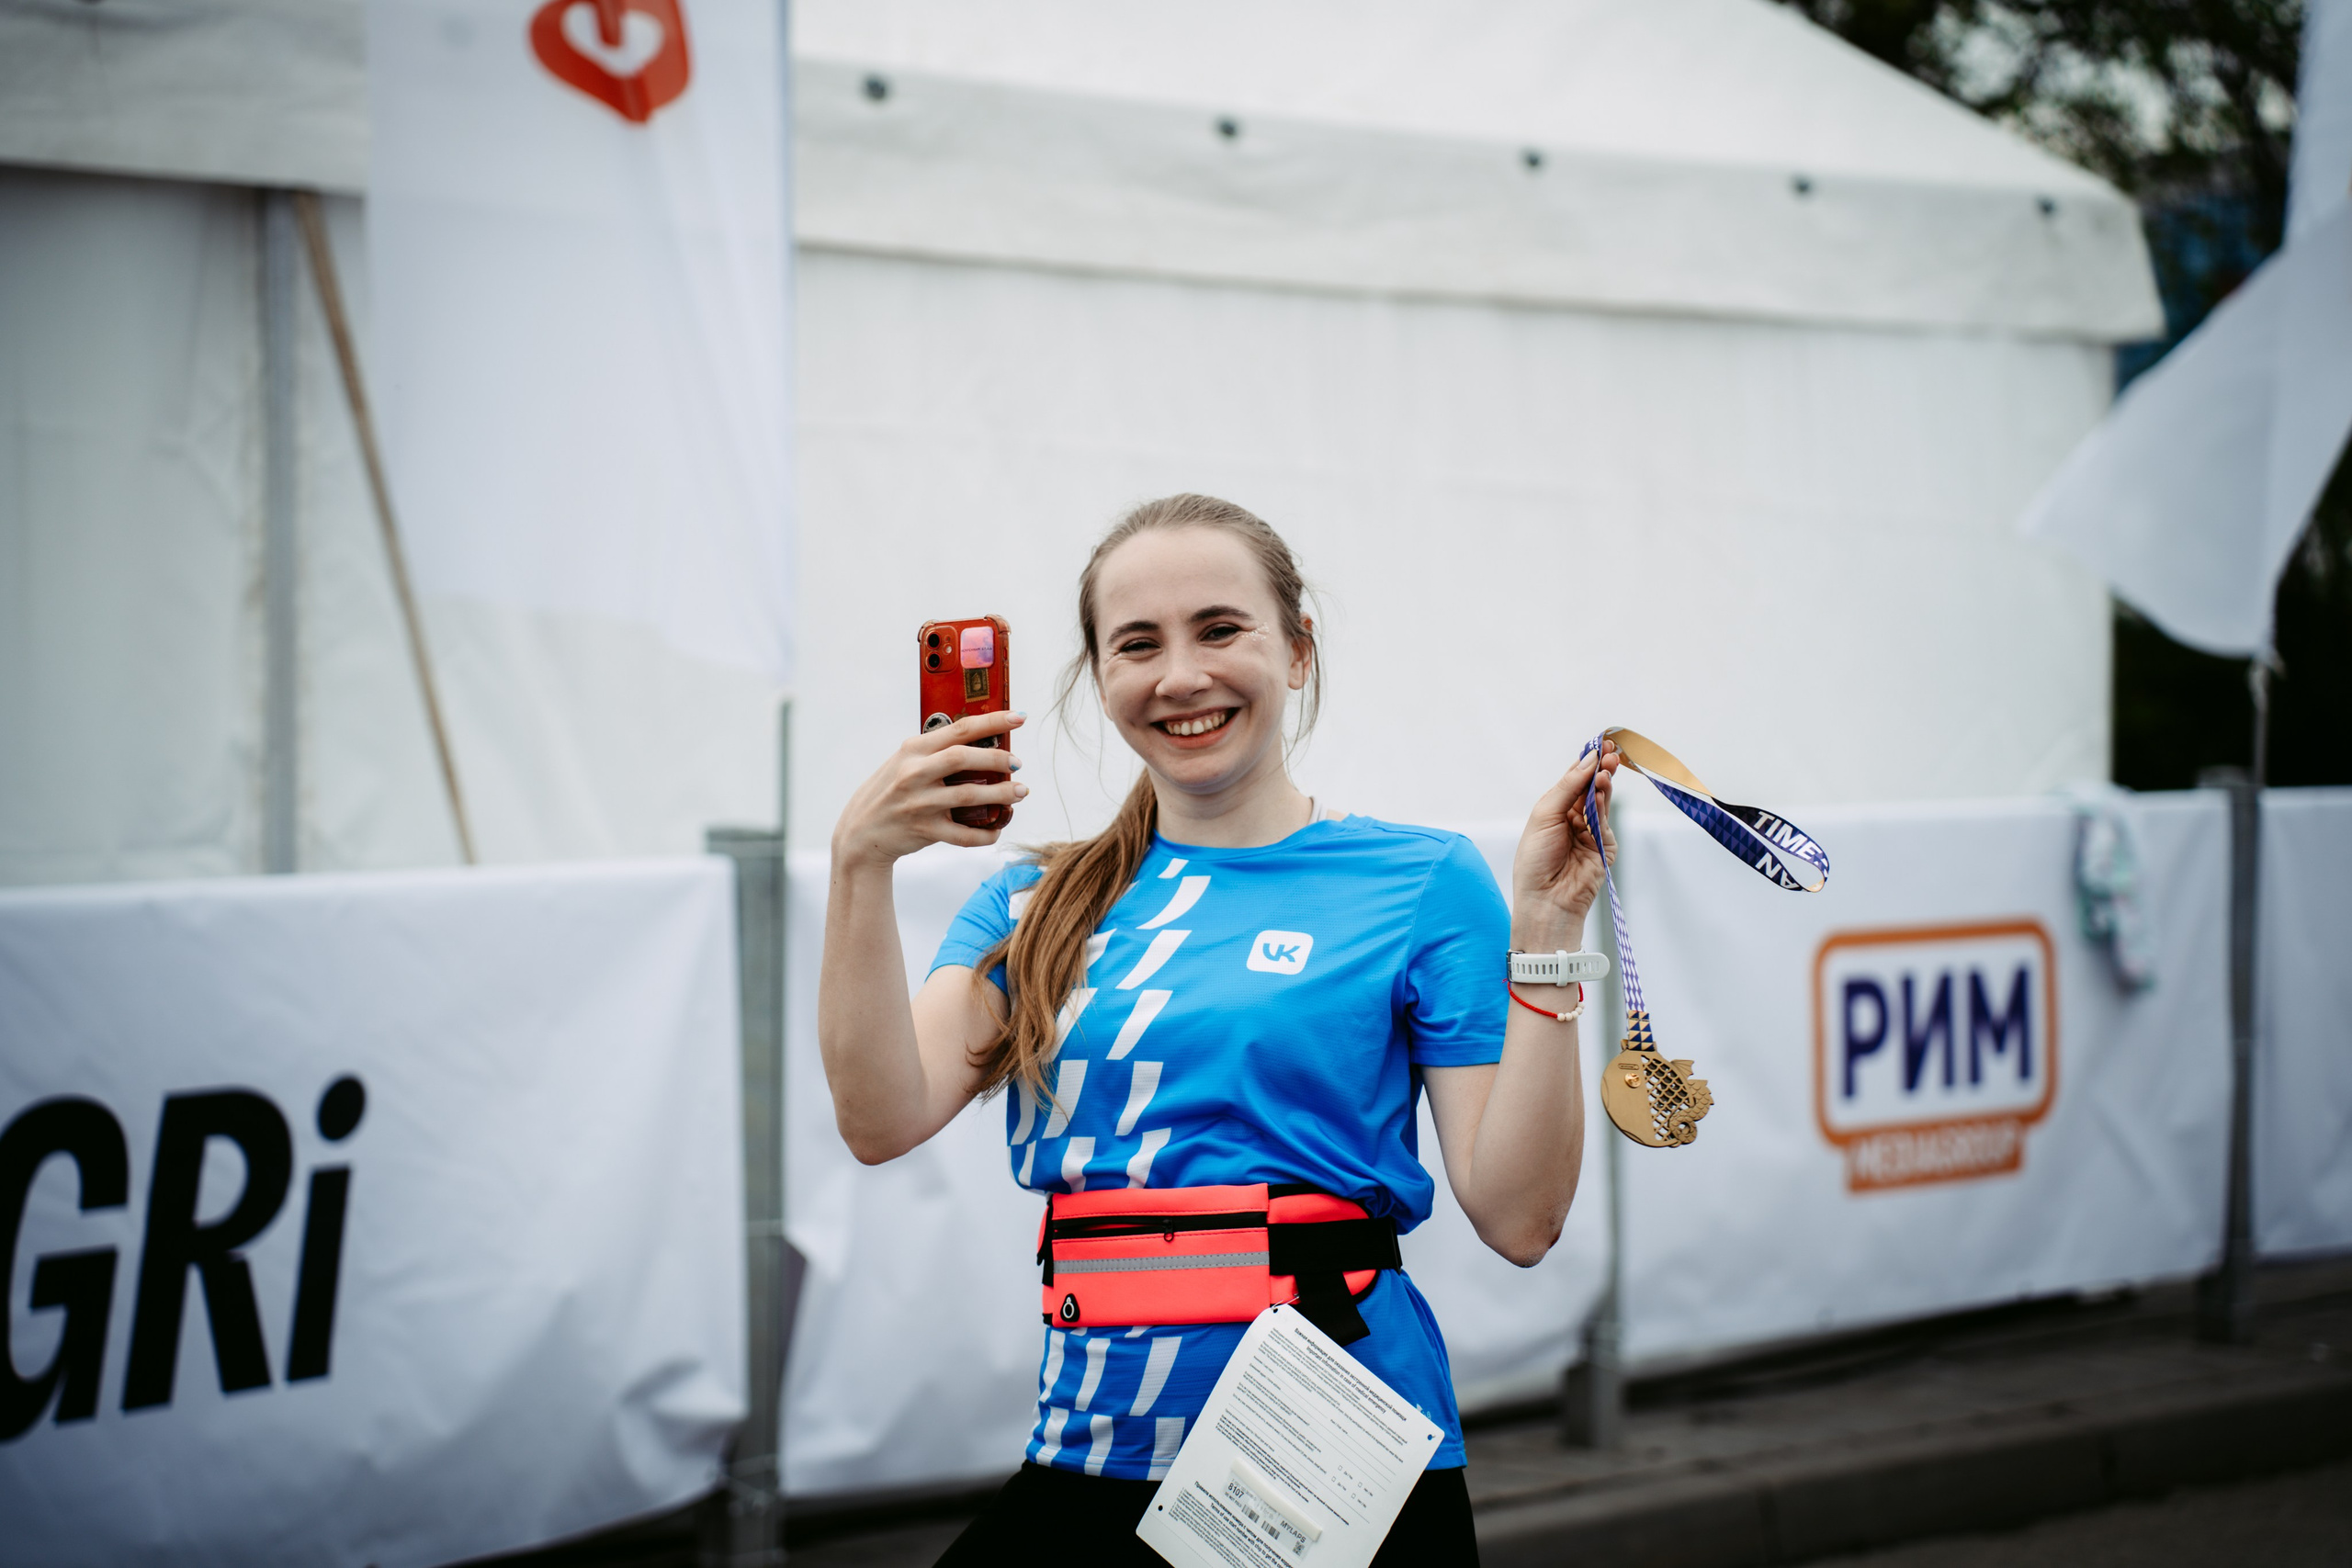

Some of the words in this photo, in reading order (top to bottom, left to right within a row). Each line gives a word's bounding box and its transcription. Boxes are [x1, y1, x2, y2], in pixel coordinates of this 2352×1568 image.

[1262, 942, 1301, 963] VK
[1841, 960, 2032, 1100] РИМ
[1306, 1346, 1322, 1360] Important
[1321, 1359, 1340, 1375] information
[1355, 1386, 1368, 1398] medical
[1367, 1397, 1385, 1414] emergency
[1227, 1483, 1244, 1498] 8107
[1209, 1503, 1220, 1513] Terms
[1236, 1527, 1248, 1539] number
[1247, 1537, 1255, 1545] with
[1253, 1543, 1262, 1551] chip
[1280, 1519, 1306, 1543] MYLAPS
